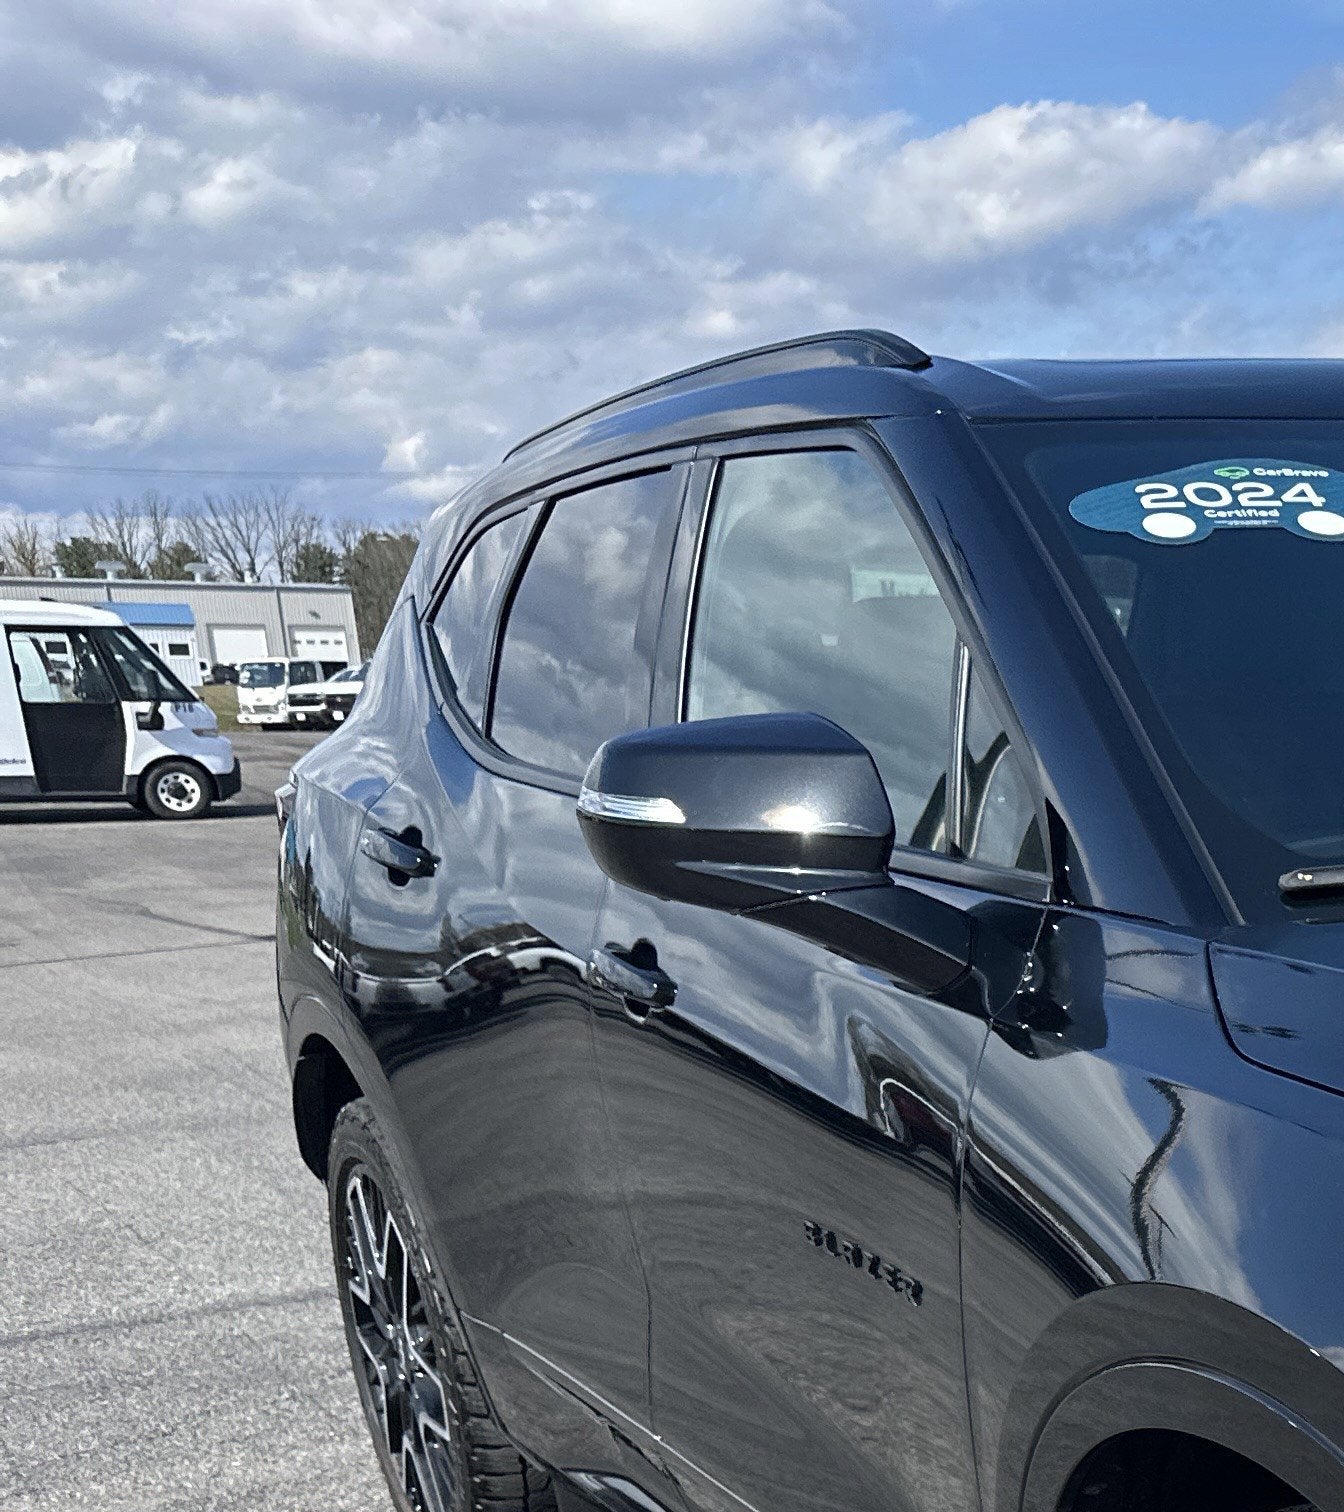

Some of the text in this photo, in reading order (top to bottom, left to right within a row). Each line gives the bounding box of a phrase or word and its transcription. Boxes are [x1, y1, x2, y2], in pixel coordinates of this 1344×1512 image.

[1134, 481, 1327, 509] 2024
[1203, 508, 1281, 519] Certified
[803, 1219, 924, 1307] BLAZER
